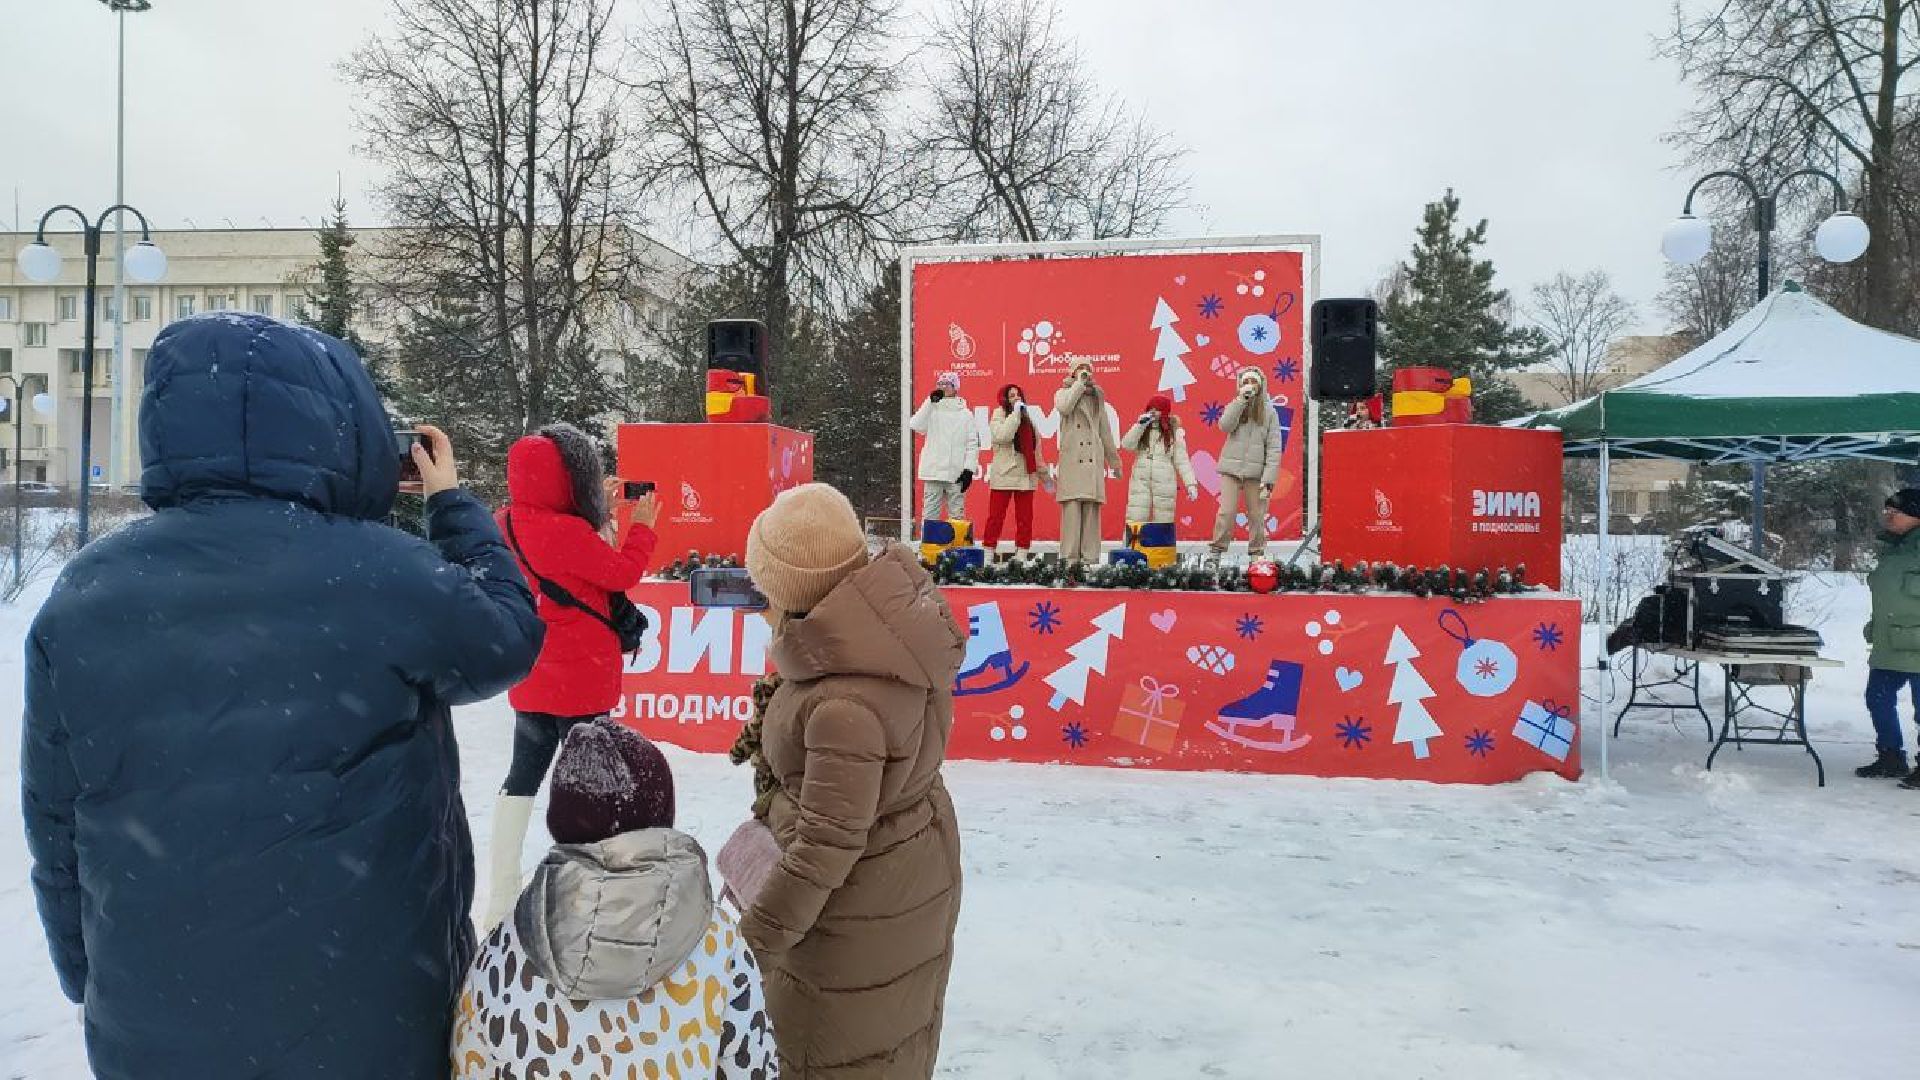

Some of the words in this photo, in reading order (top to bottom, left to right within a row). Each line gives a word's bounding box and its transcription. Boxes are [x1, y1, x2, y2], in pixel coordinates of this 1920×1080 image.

[1472, 489, 1541, 517] ЗИМА
[622, 603, 773, 676] ЗИ
[635, 693, 754, 724] ПОДМО
